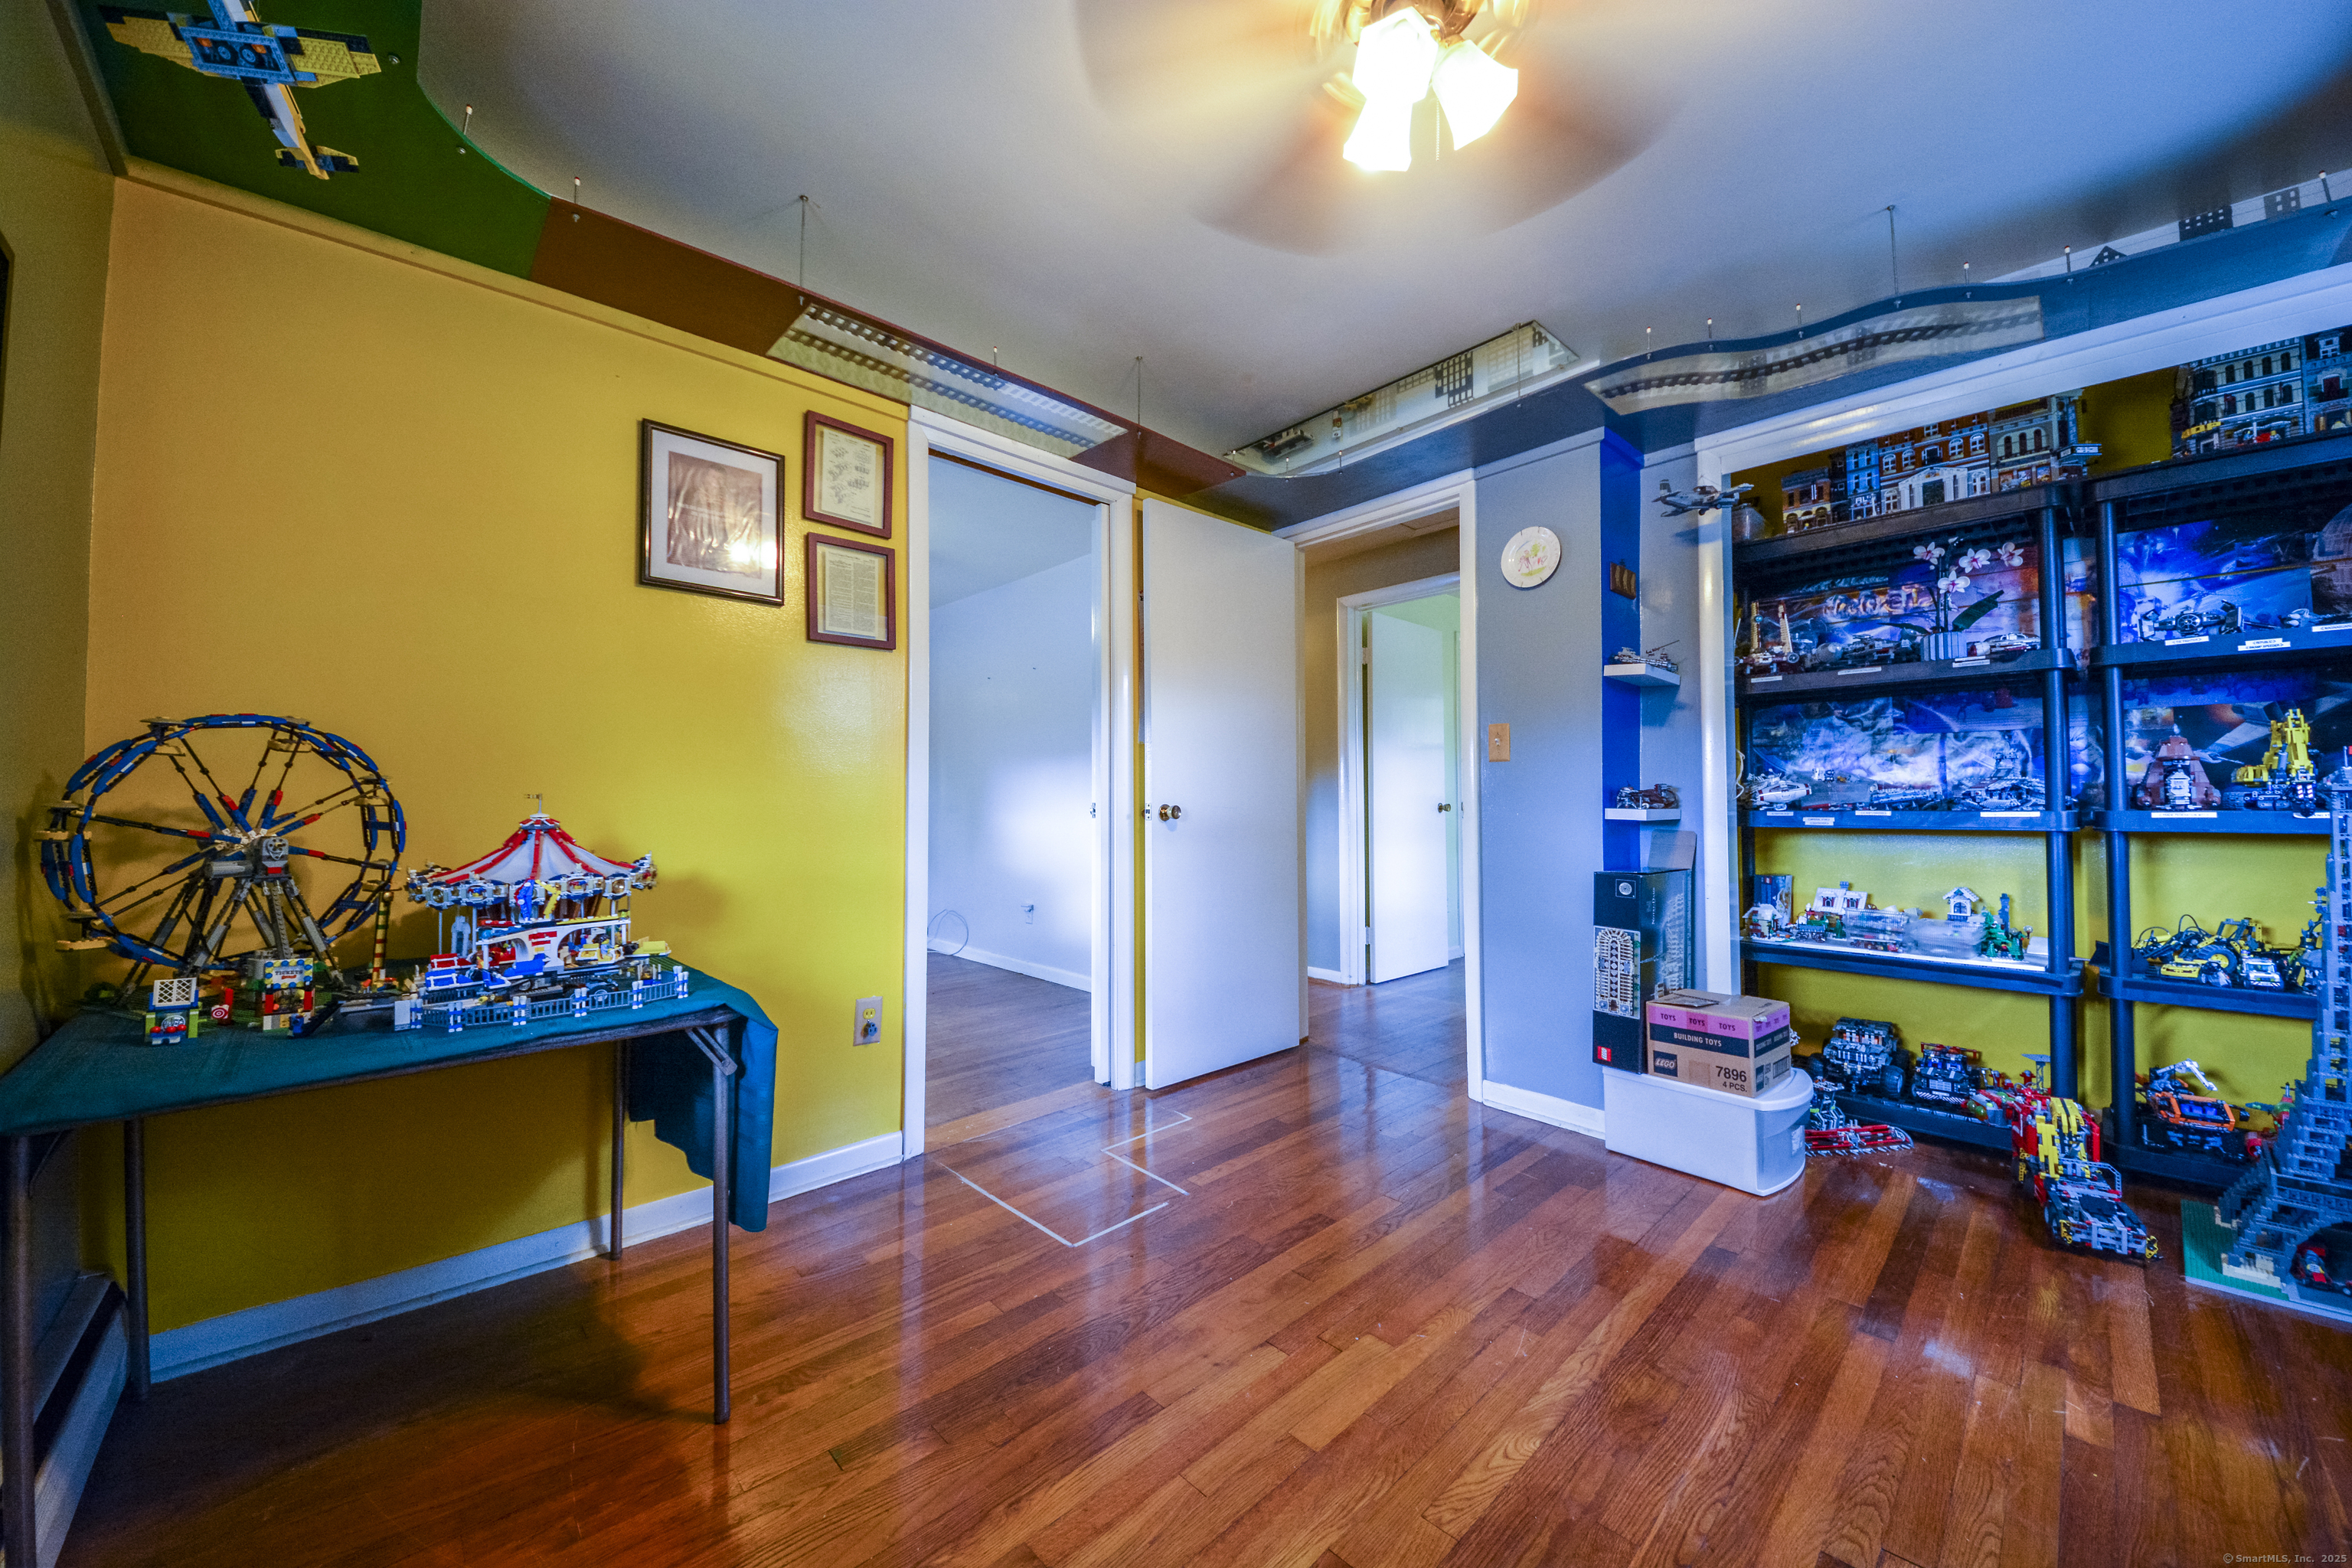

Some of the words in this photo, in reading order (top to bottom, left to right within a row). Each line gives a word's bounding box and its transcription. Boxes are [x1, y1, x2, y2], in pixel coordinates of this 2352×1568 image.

[1660, 1013, 1676, 1021] TOYS
[1689, 1018, 1705, 1026] TOYS
[1719, 1023, 1736, 1031] TOYS
[1674, 1032, 1703, 1044] BUILDING
[1705, 1037, 1722, 1047] TOYS
[1655, 1058, 1675, 1069] LEGO
[1715, 1065, 1747, 1083] 7896
[1729, 1082, 1747, 1093] PCS.
